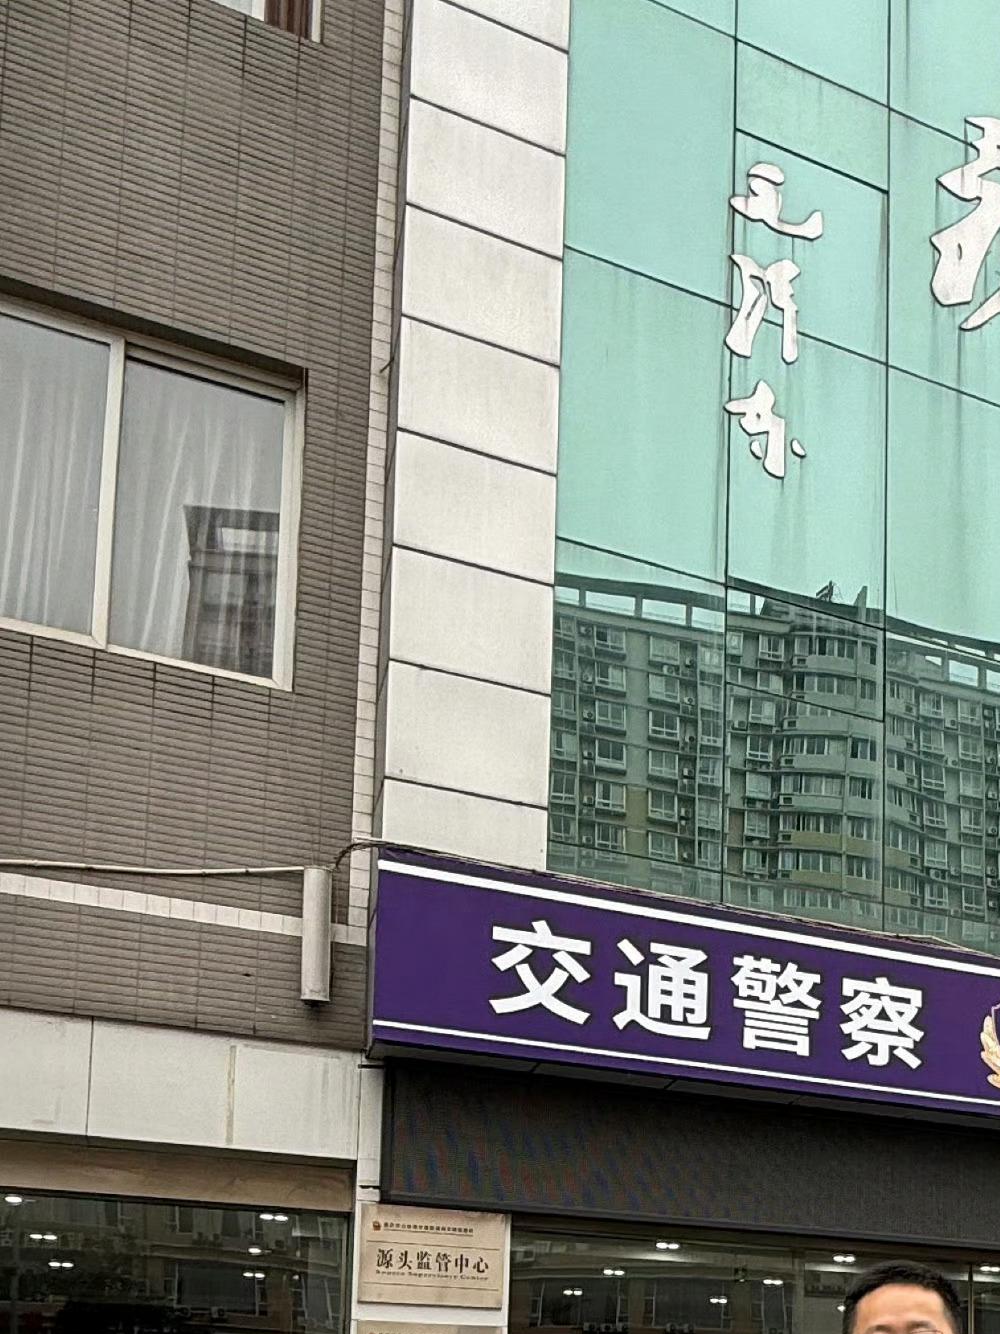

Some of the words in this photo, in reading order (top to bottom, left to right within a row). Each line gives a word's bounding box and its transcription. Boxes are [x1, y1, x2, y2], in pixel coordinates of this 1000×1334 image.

[487, 919, 926, 1069] 交通警察
[376, 1248, 489, 1273] 源头监管中心
